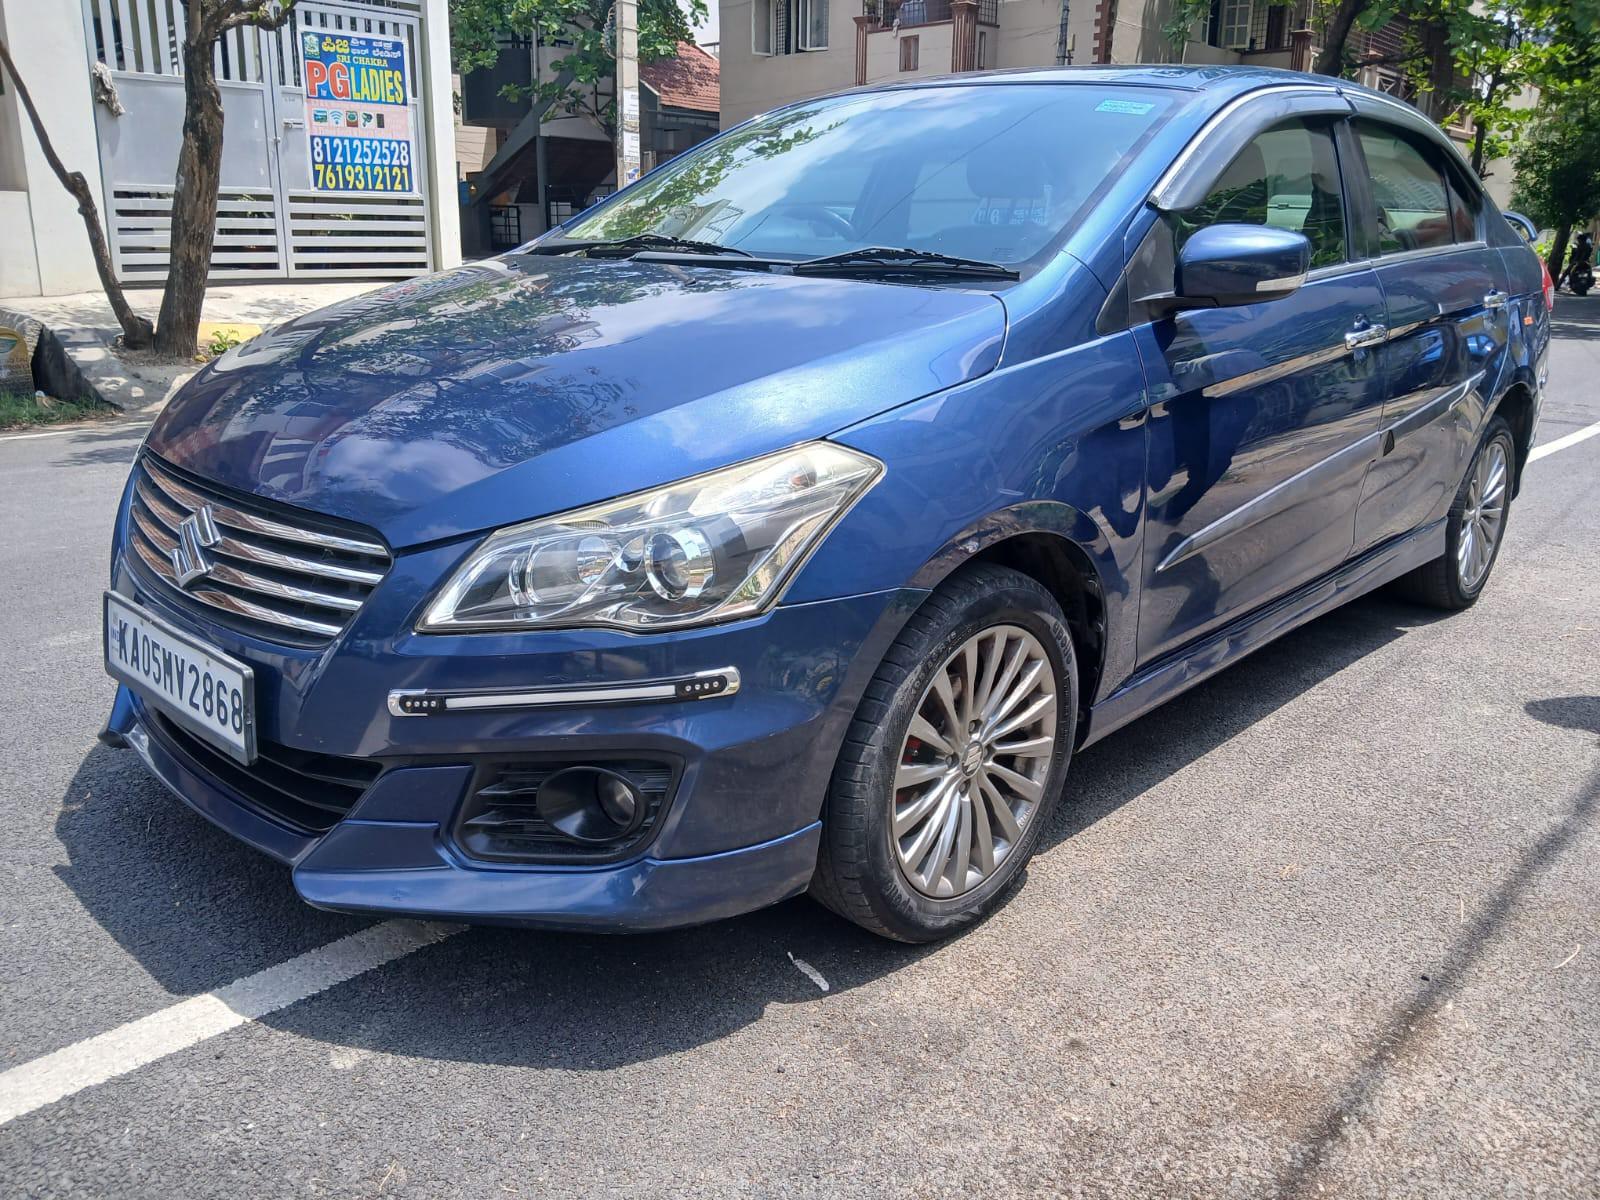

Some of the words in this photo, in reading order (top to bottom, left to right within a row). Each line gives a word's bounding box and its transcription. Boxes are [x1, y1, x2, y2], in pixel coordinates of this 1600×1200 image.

[336, 54, 351, 64] SRI
[352, 56, 388, 67] CHAKRA
[305, 60, 351, 100] PG
[351, 69, 404, 104] LADIES
[313, 136, 409, 165] 8121252528
[314, 164, 409, 190] 7619312121
[118, 619, 243, 735] KA05MV2868
